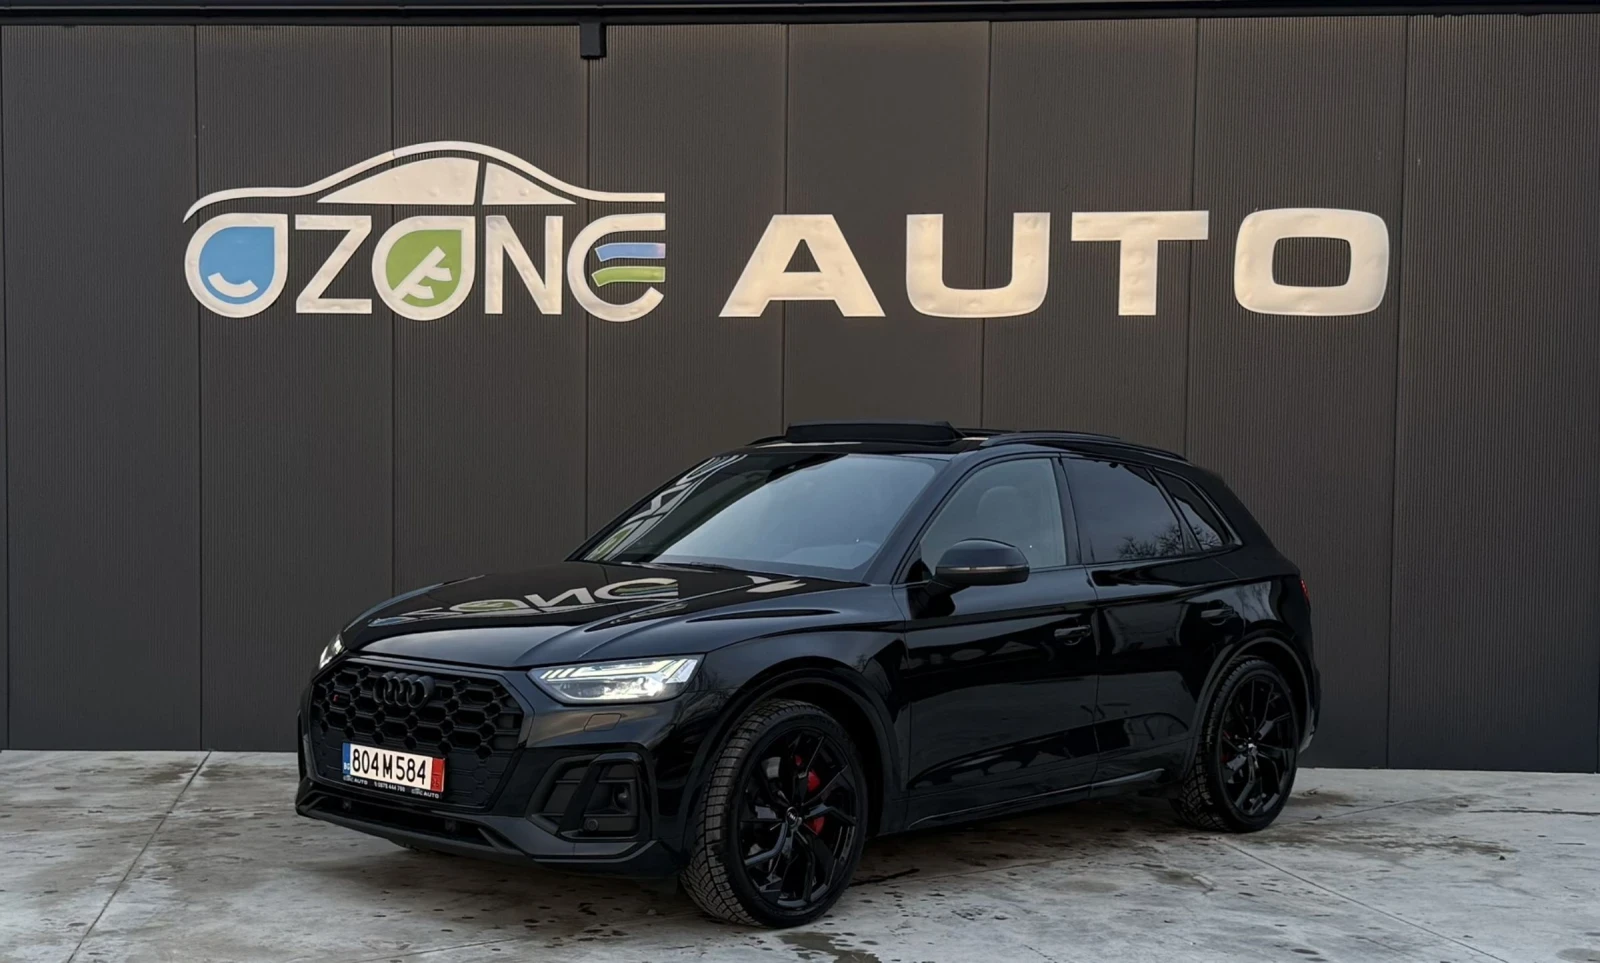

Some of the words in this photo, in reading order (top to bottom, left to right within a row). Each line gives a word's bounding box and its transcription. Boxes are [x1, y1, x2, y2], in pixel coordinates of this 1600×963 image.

[184, 213, 666, 322] OZONE
[719, 207, 1391, 318] AUTO
[423, 791, 440, 799] AUTO
